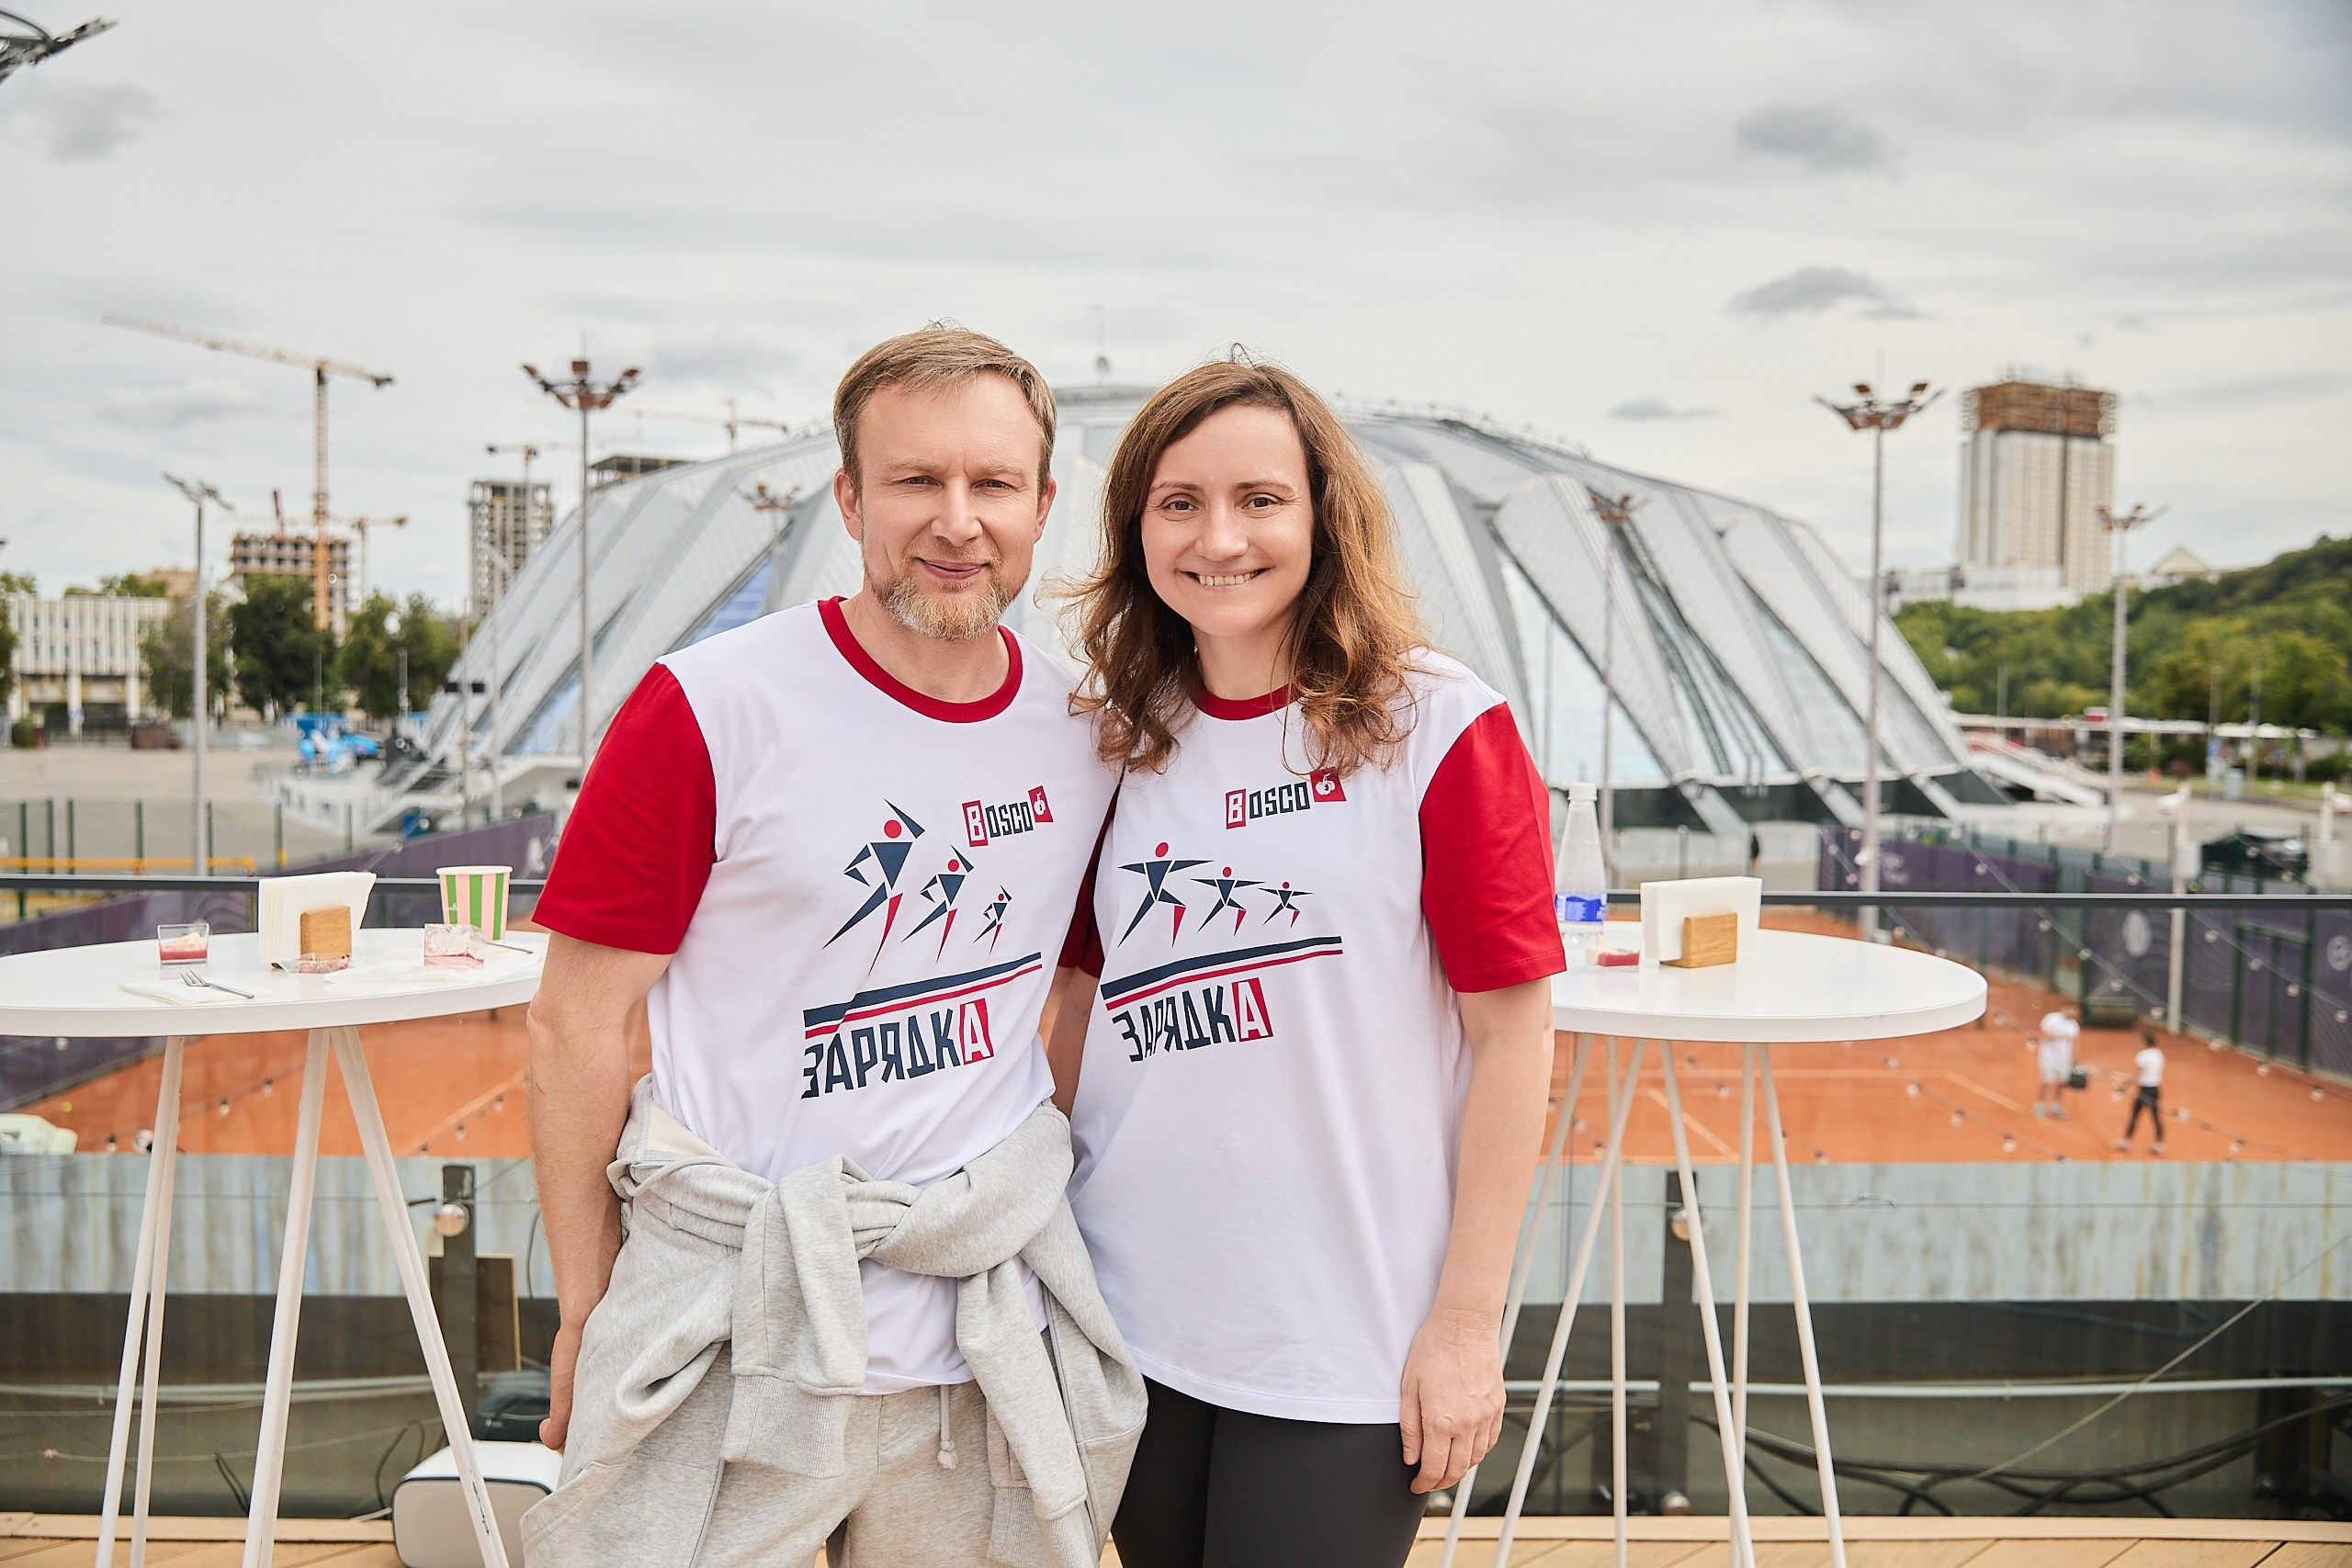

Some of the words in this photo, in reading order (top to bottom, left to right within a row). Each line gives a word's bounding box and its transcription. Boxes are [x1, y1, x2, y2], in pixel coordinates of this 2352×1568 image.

[963, 800, 1035, 846] BOSCO
[1226, 782, 1311, 829] BOSCO
[801, 998, 993, 1100] ЗАРЯДКА
[1112, 978, 1272, 1062] ЗАРЯДКА
